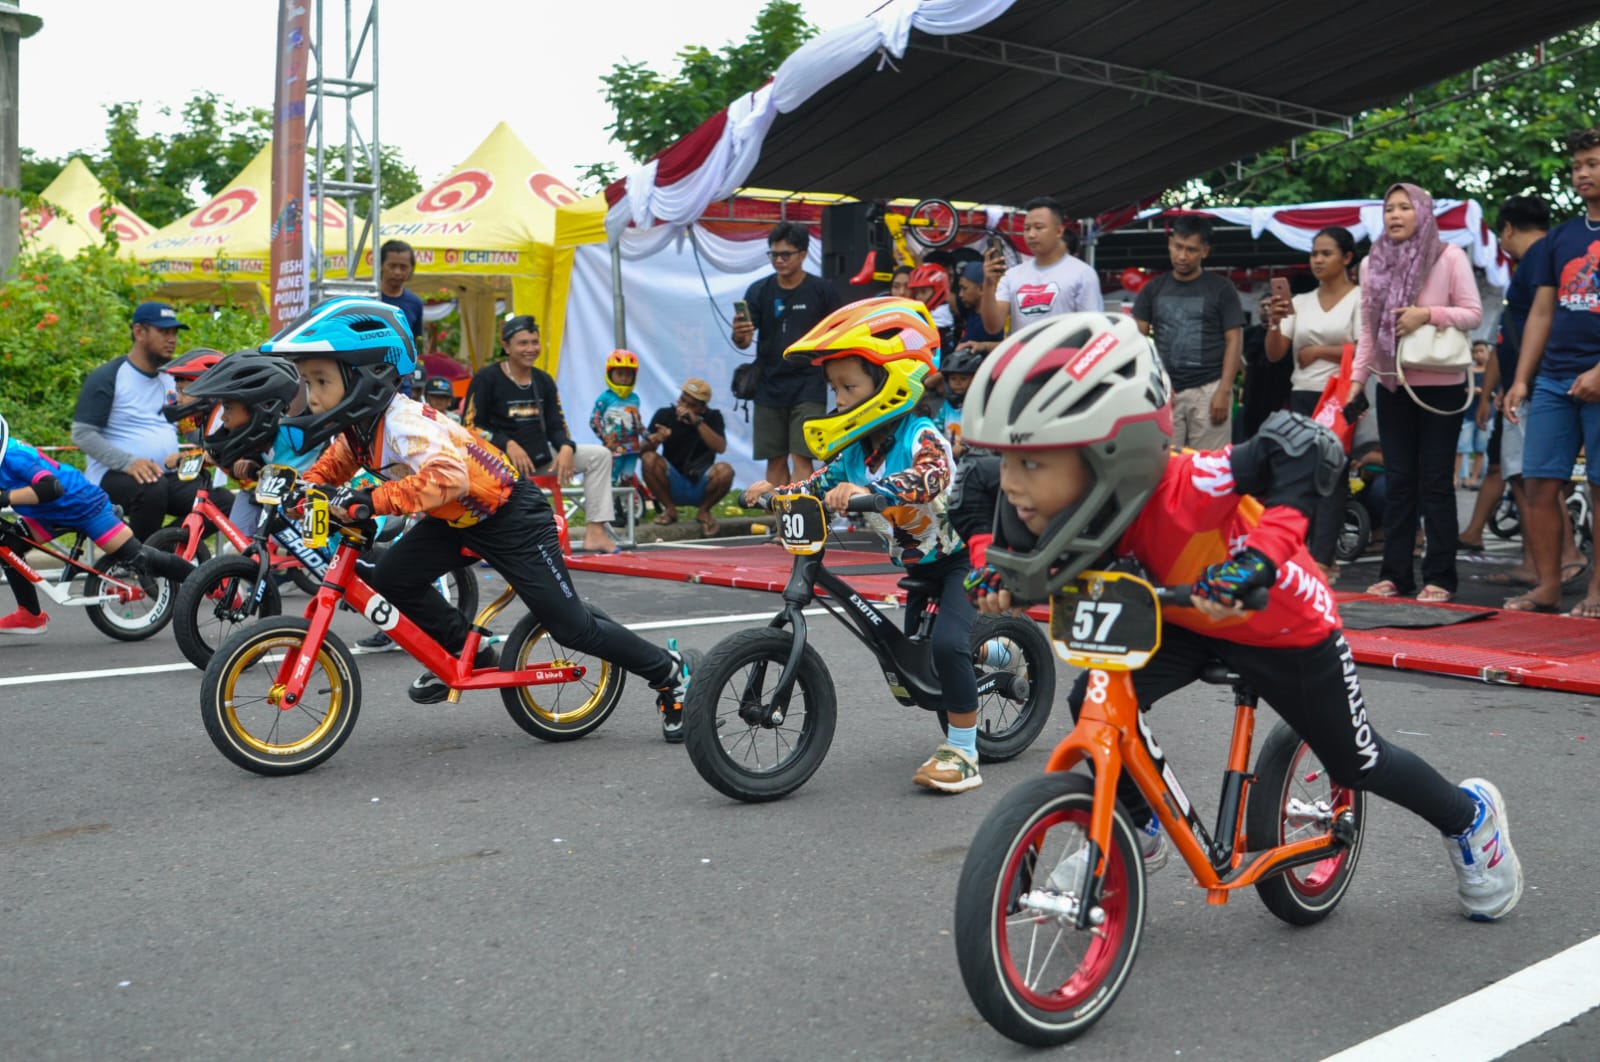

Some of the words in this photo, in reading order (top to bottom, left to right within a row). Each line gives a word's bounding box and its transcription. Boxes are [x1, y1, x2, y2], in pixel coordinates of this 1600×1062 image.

[462, 250, 518, 264] ICHITAN
[262, 476, 286, 494] 412
[315, 509, 326, 536] B
[782, 513, 804, 538] 30
[850, 593, 883, 626] EXOTIC
[1072, 601, 1122, 642] 57
